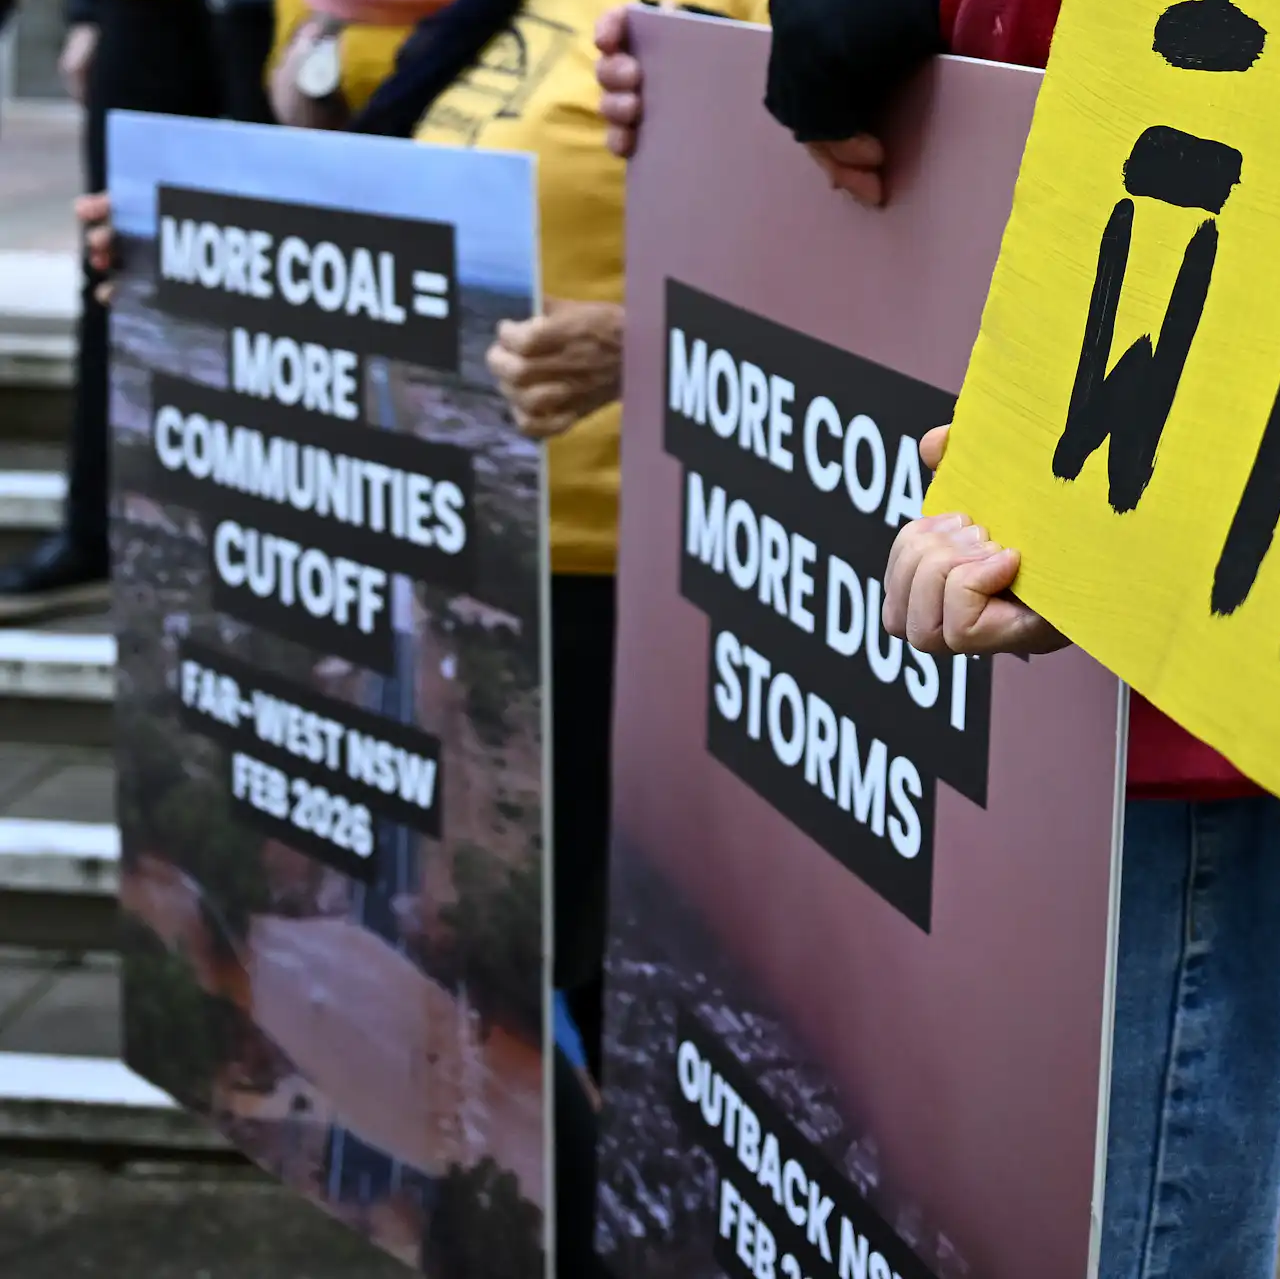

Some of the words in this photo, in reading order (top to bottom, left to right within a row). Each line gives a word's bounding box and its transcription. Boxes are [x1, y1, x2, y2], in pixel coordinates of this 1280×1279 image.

[160, 215, 273, 300] MORE
[277, 236, 406, 323] COAL
[412, 270, 449, 319] =
[232, 327, 359, 421] MORE
[668, 327, 795, 473] MORE
[803, 395, 925, 529] COA
[154, 405, 466, 554] COMMUNITIES
[686, 470, 817, 634] MORE
[214, 519, 386, 634] CUTOFF
[180, 659, 345, 771] FAR-WEST
[346, 728, 437, 809] NSW
[232, 751, 289, 819] FEB
[290, 777, 374, 858] 2026
[714, 630, 923, 859] STORMS
[677, 1040, 835, 1263] OUTBACK
[719, 1178, 776, 1279] FEB
